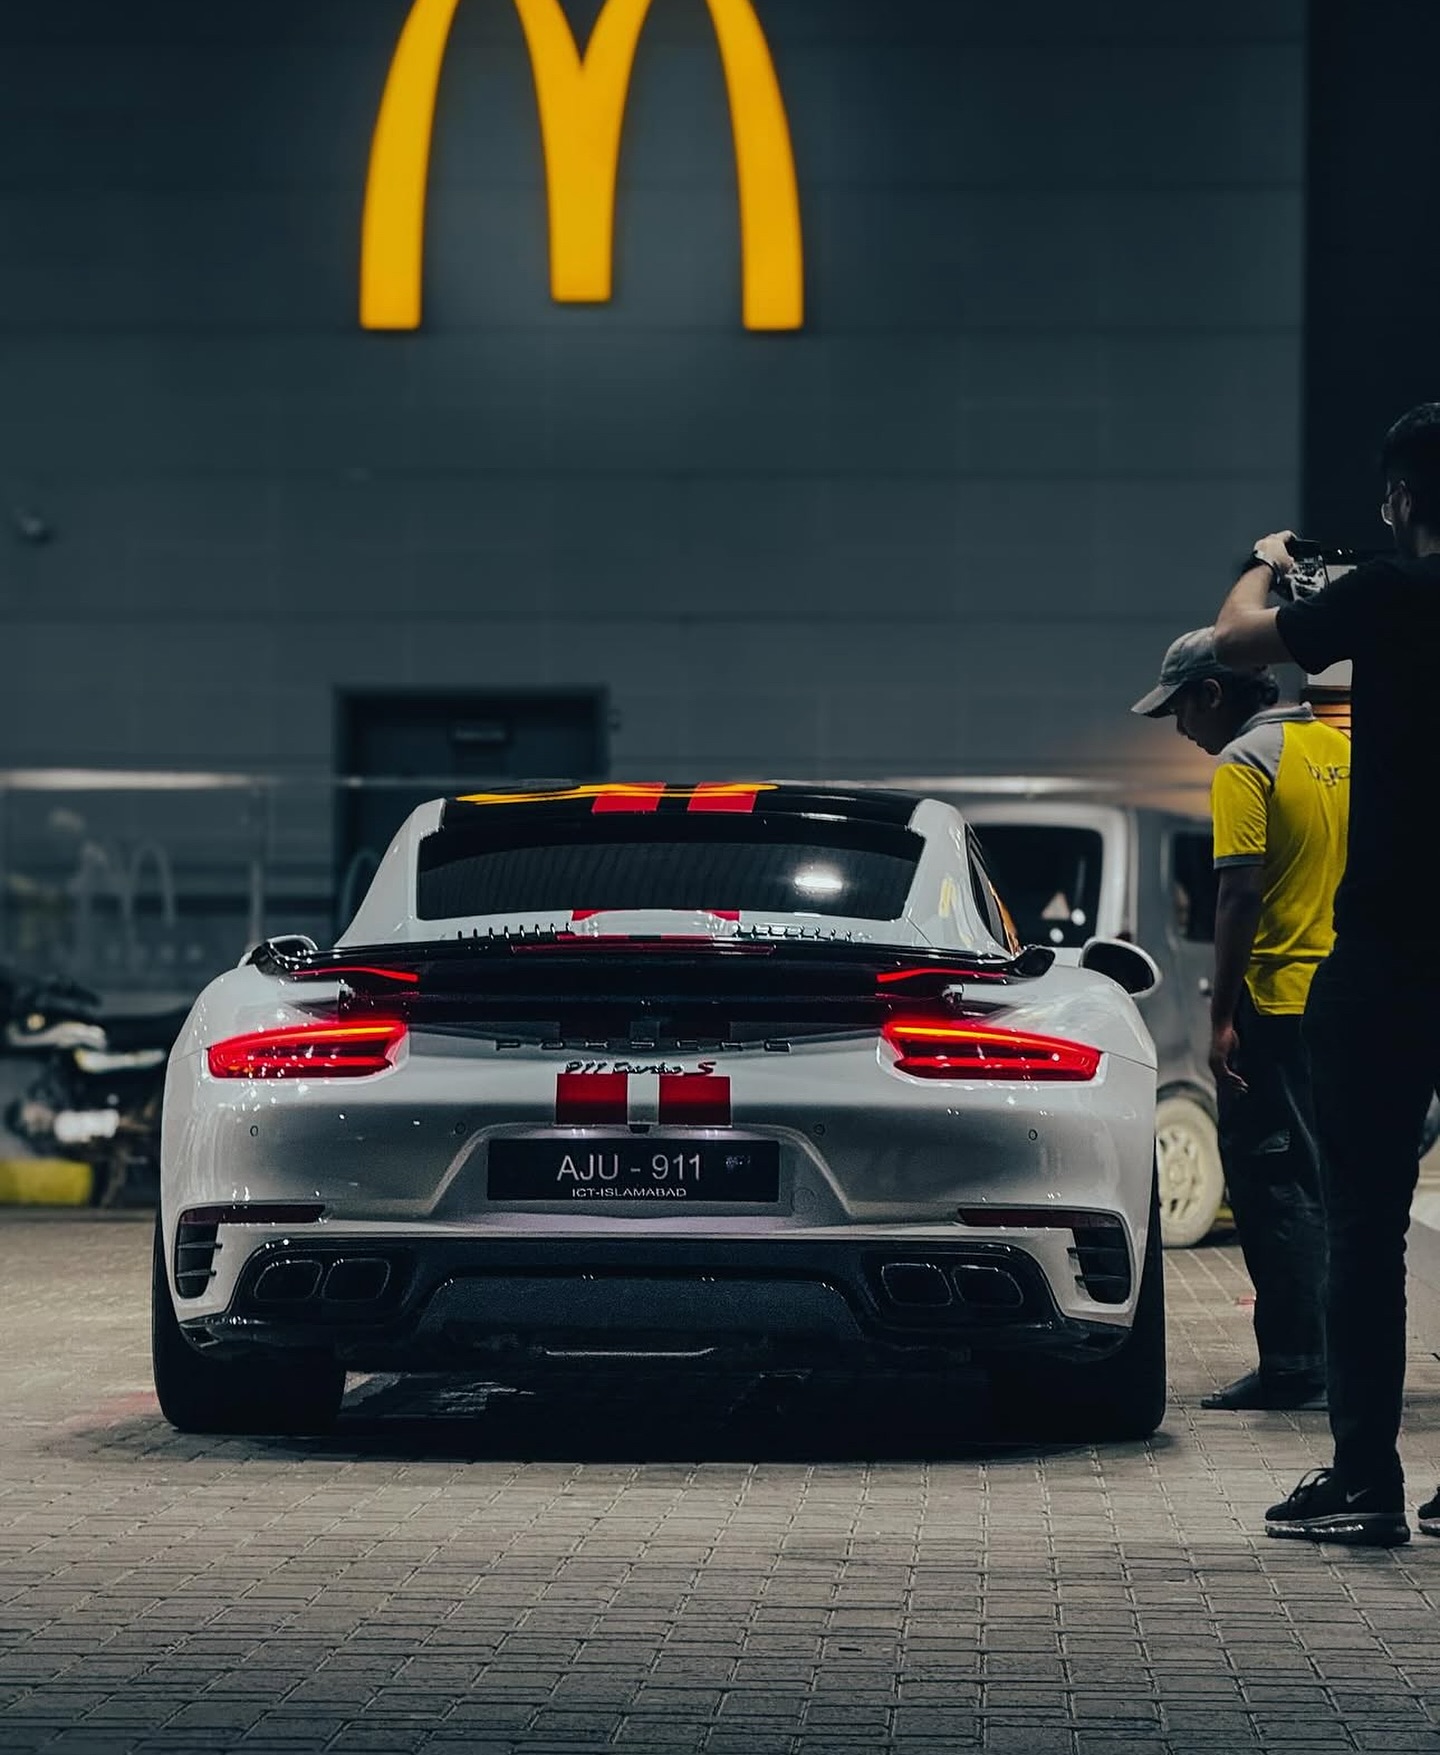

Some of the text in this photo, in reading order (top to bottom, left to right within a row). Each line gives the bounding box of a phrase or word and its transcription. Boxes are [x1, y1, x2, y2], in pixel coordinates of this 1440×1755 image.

[682, 1060, 717, 1076] S
[556, 1153, 619, 1181] AJU
[651, 1153, 700, 1181] 911
[572, 1187, 687, 1198] ICT-ISLAMABAD
